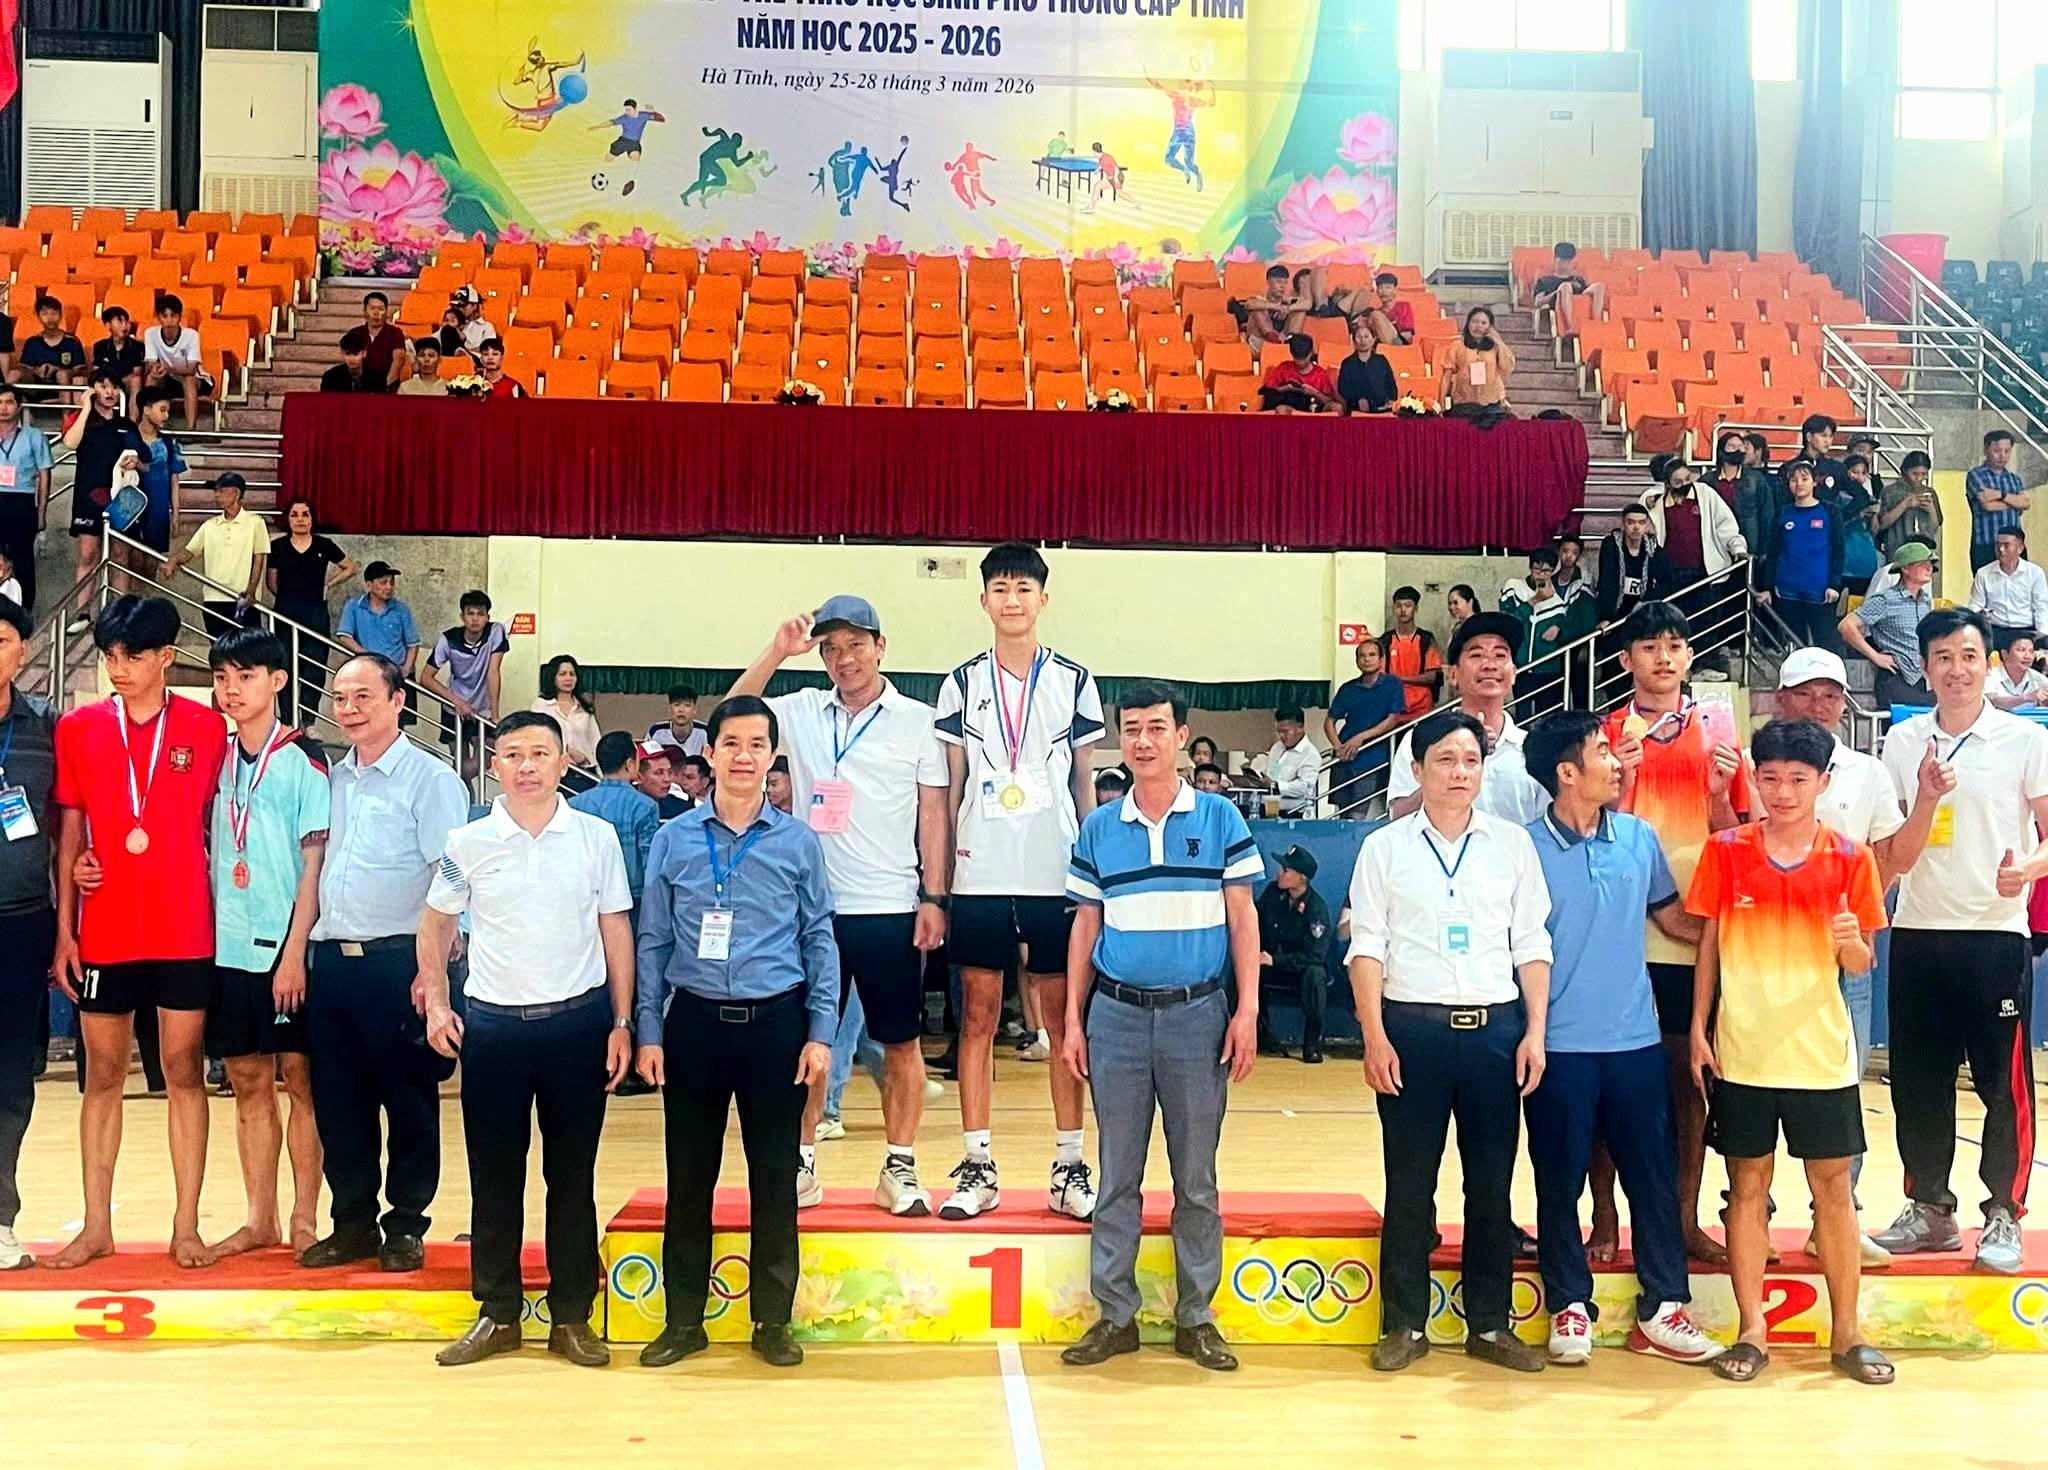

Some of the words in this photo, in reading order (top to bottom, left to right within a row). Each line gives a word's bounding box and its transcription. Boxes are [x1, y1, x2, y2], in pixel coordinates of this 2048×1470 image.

[737, 12, 795, 50] NĂM
[802, 19, 852, 56] HỌC
[858, 22, 917, 54] 2025
[941, 24, 1001, 57] 2026
[701, 67, 727, 84] Hà
[783, 71, 824, 92] ngày
[829, 72, 877, 90] 25-28
[882, 73, 931, 95] tháng
[936, 75, 946, 92] 3
[952, 77, 988, 93] năm
[994, 77, 1035, 94] 2026
[969, 1247, 1022, 1328] 1
[74, 1296, 156, 1340] 3
[1762, 1279, 1818, 1343] 2
